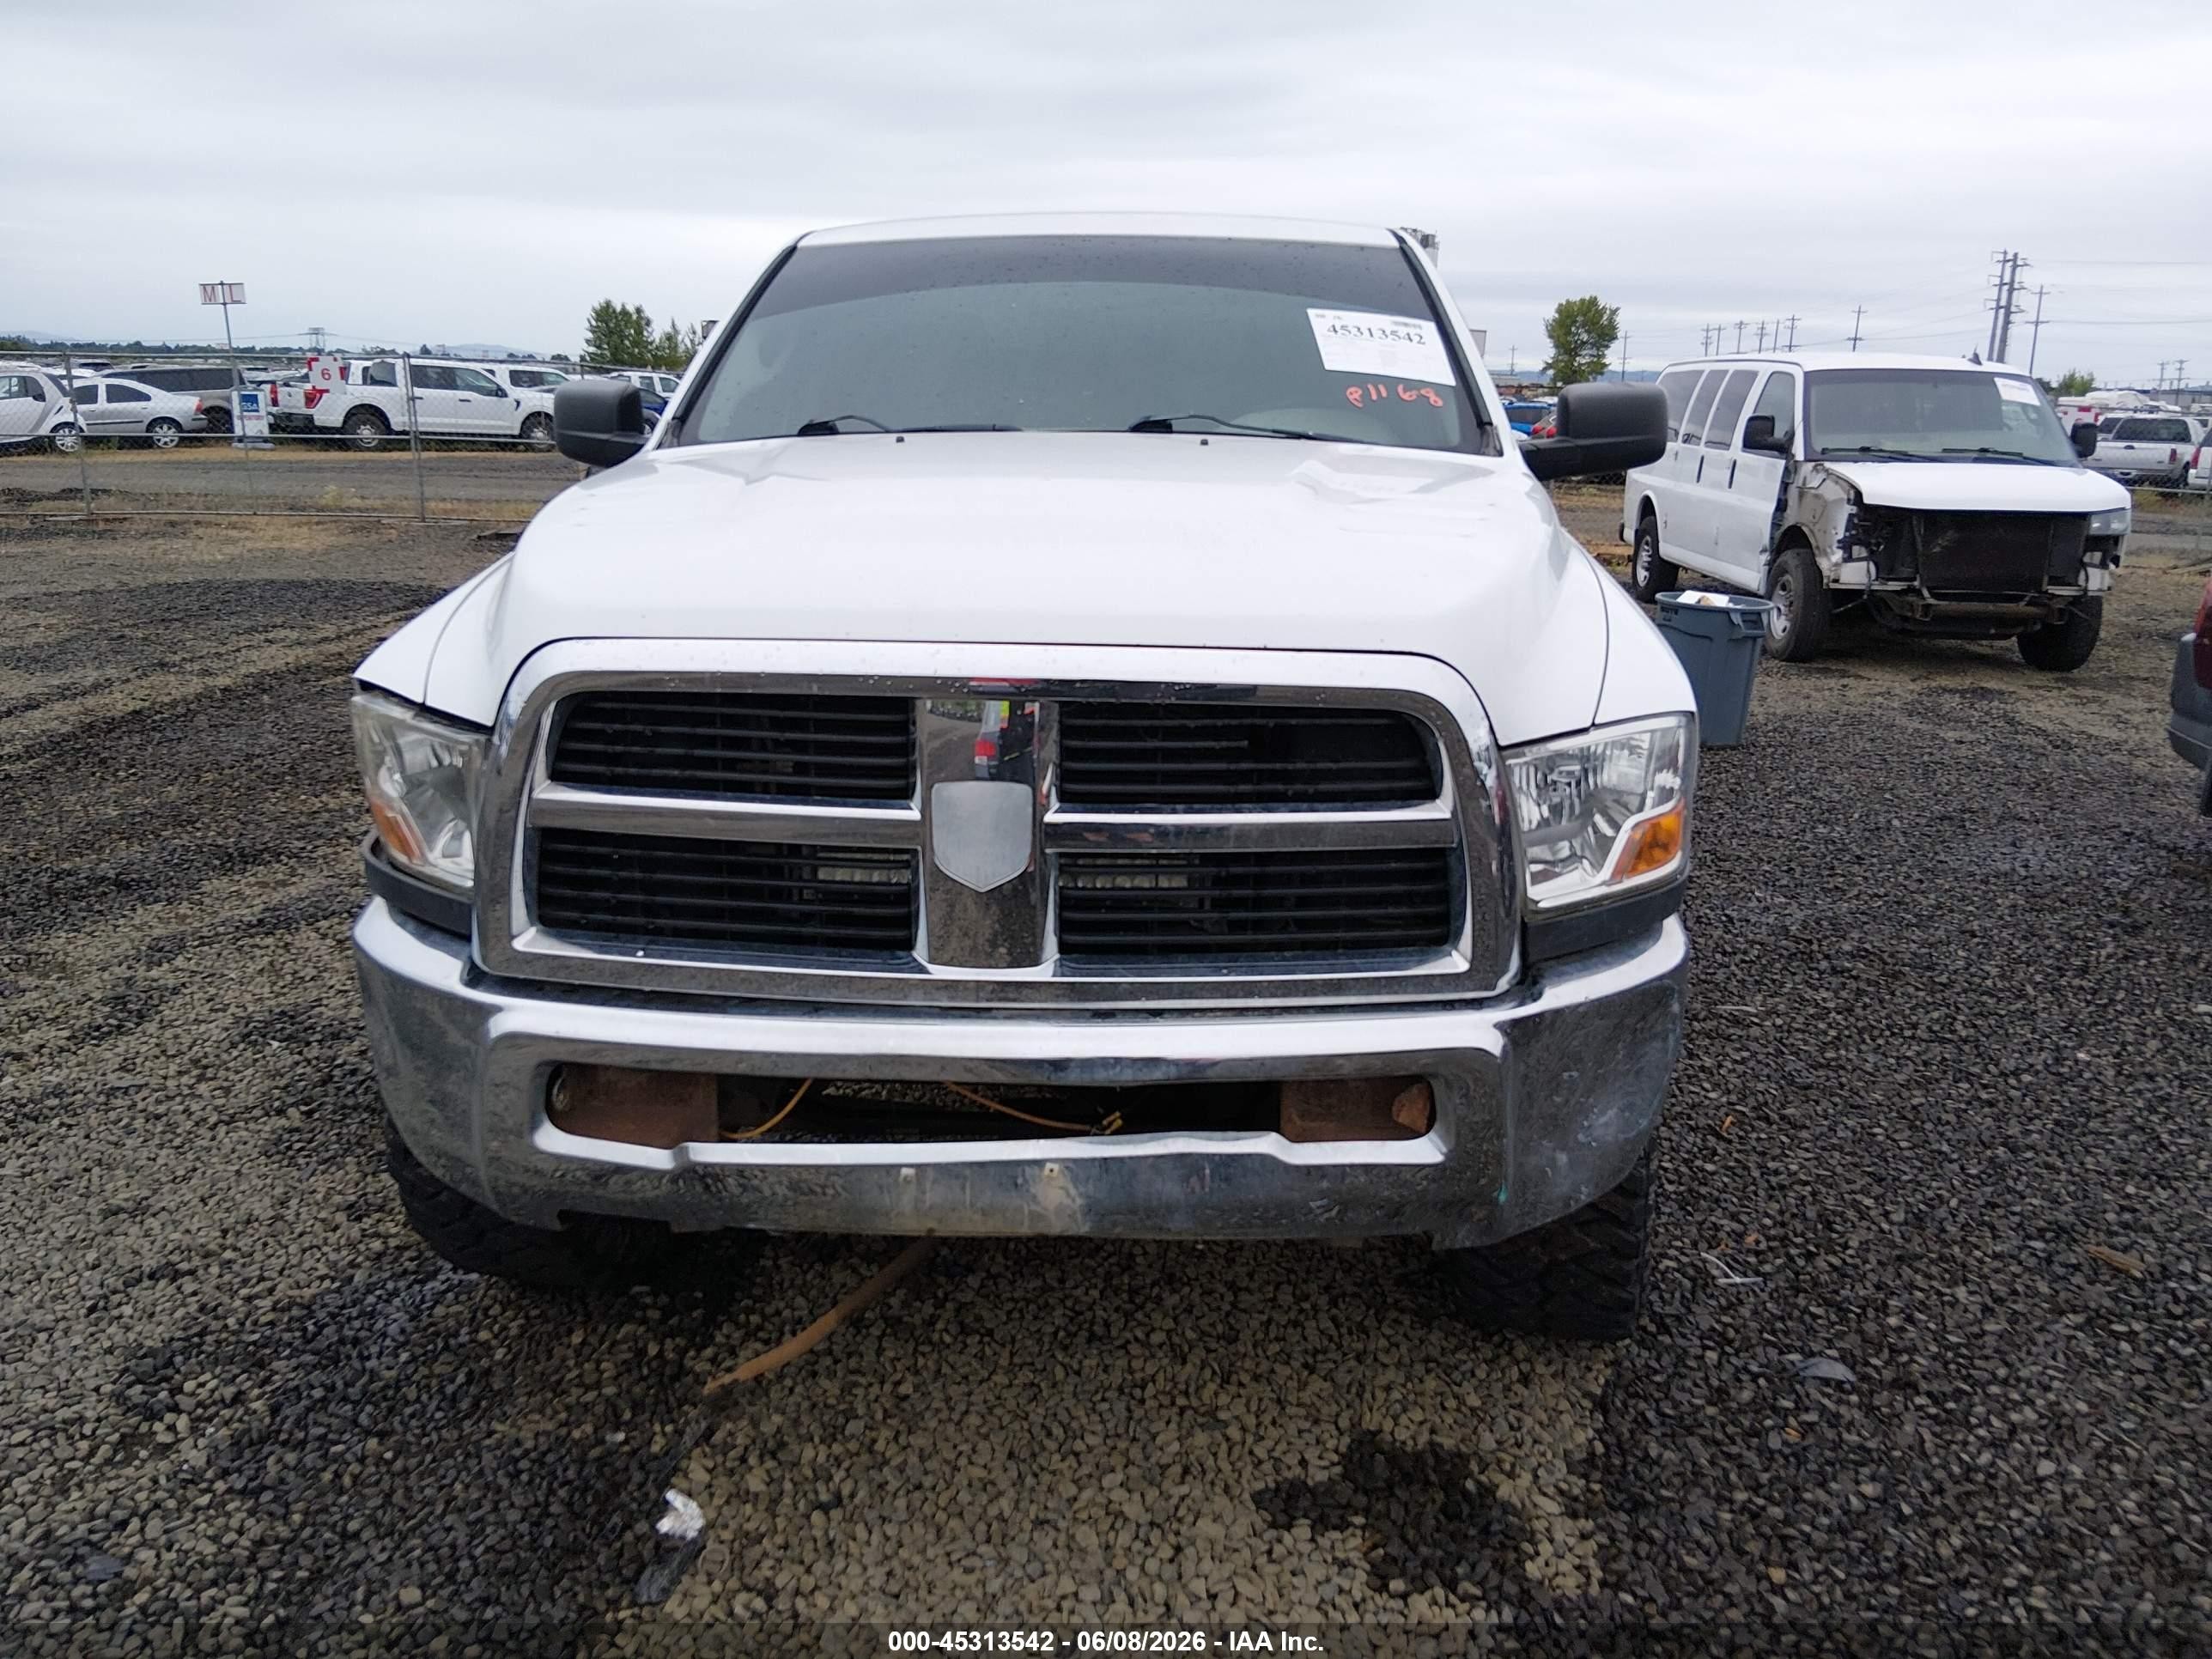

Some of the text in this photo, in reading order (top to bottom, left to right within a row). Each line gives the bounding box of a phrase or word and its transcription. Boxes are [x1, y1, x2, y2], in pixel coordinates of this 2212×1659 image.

[203, 285, 241, 302] M L
[1327, 324, 1426, 344] 45313542
[321, 368, 331, 380] 6
